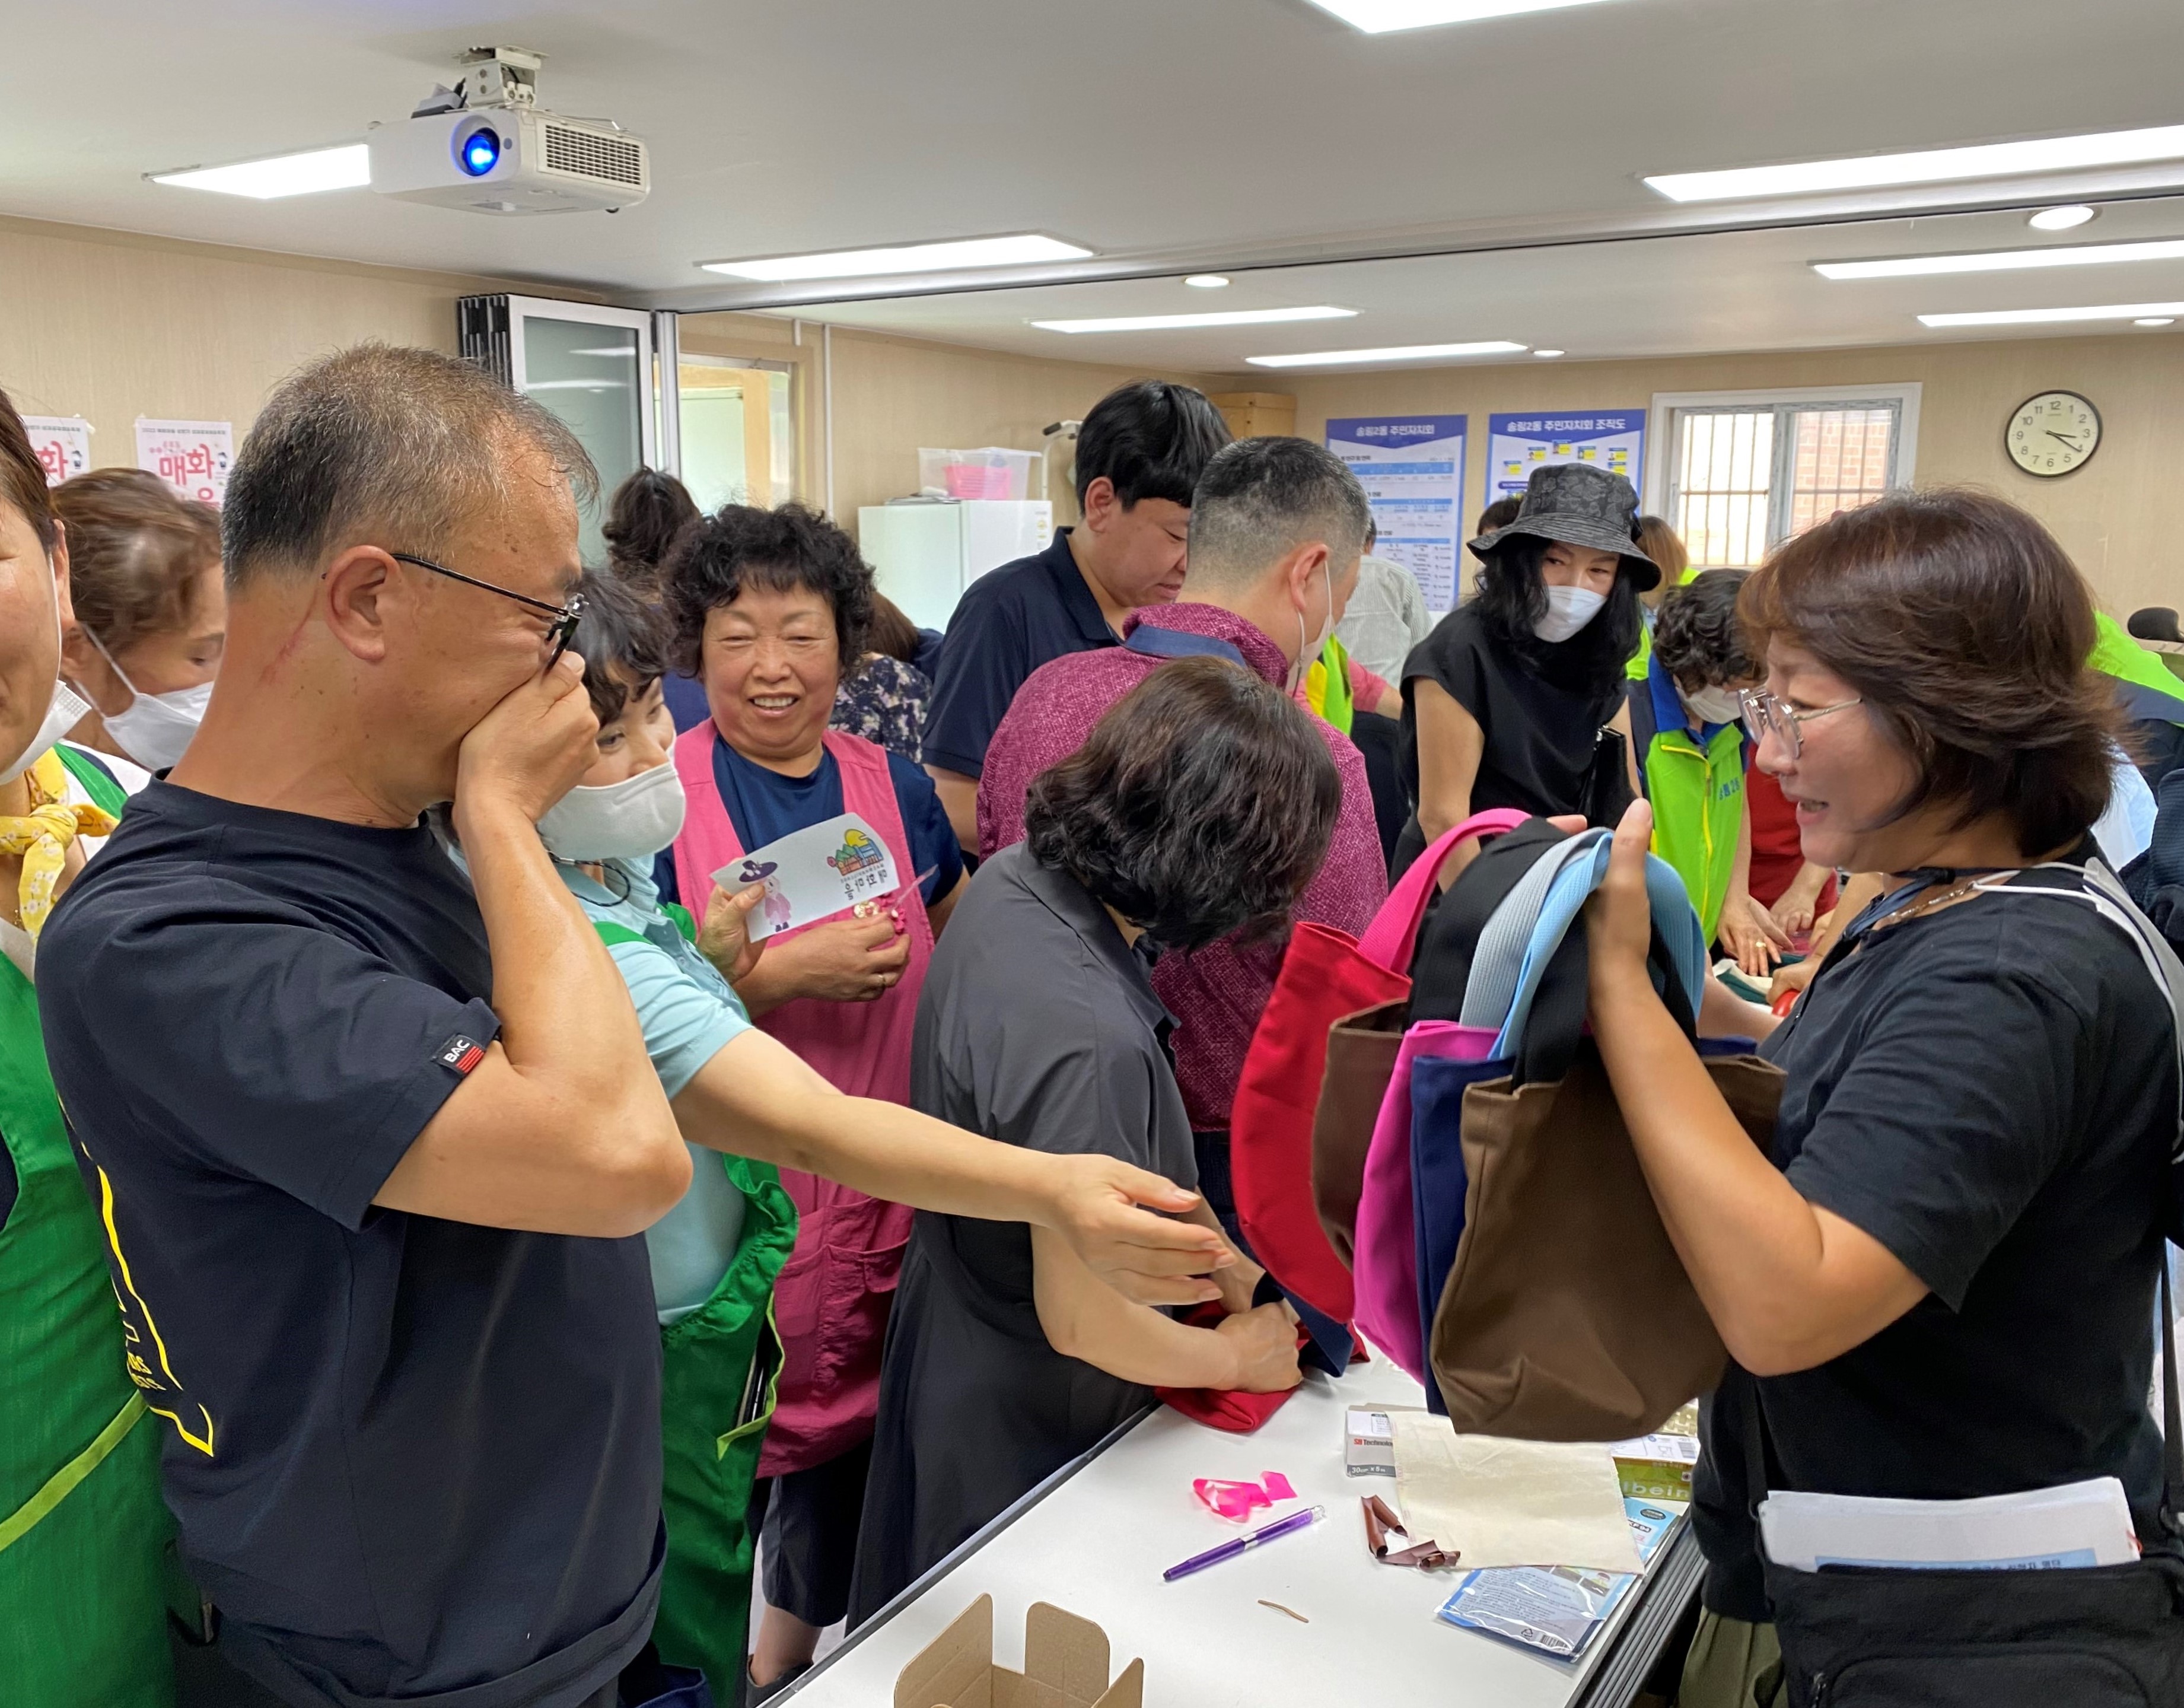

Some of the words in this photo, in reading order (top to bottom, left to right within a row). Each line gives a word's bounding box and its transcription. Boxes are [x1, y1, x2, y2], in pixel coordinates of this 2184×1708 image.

[2035, 405, 2043, 414] 11
[2049, 400, 2061, 410] 12
[2022, 416, 2033, 425] 10
[2078, 414, 2087, 423] 2
[1390, 424, 1434, 435] 주민자치회
[1544, 419, 1593, 431] 주민자치회
[1596, 419, 1626, 430] 조직도
[2016, 431, 2024, 440] 9
[2083, 428, 2090, 438] 3
[2021, 446, 2028, 455] 8
[36, 441, 69, 479] 화
[2032, 455, 2040, 465] 7
[2046, 458, 2054, 467] 6
[2064, 453, 2071, 463] 5
[159, 443, 215, 486] 매화
[443, 1040, 470, 1063] BAC
